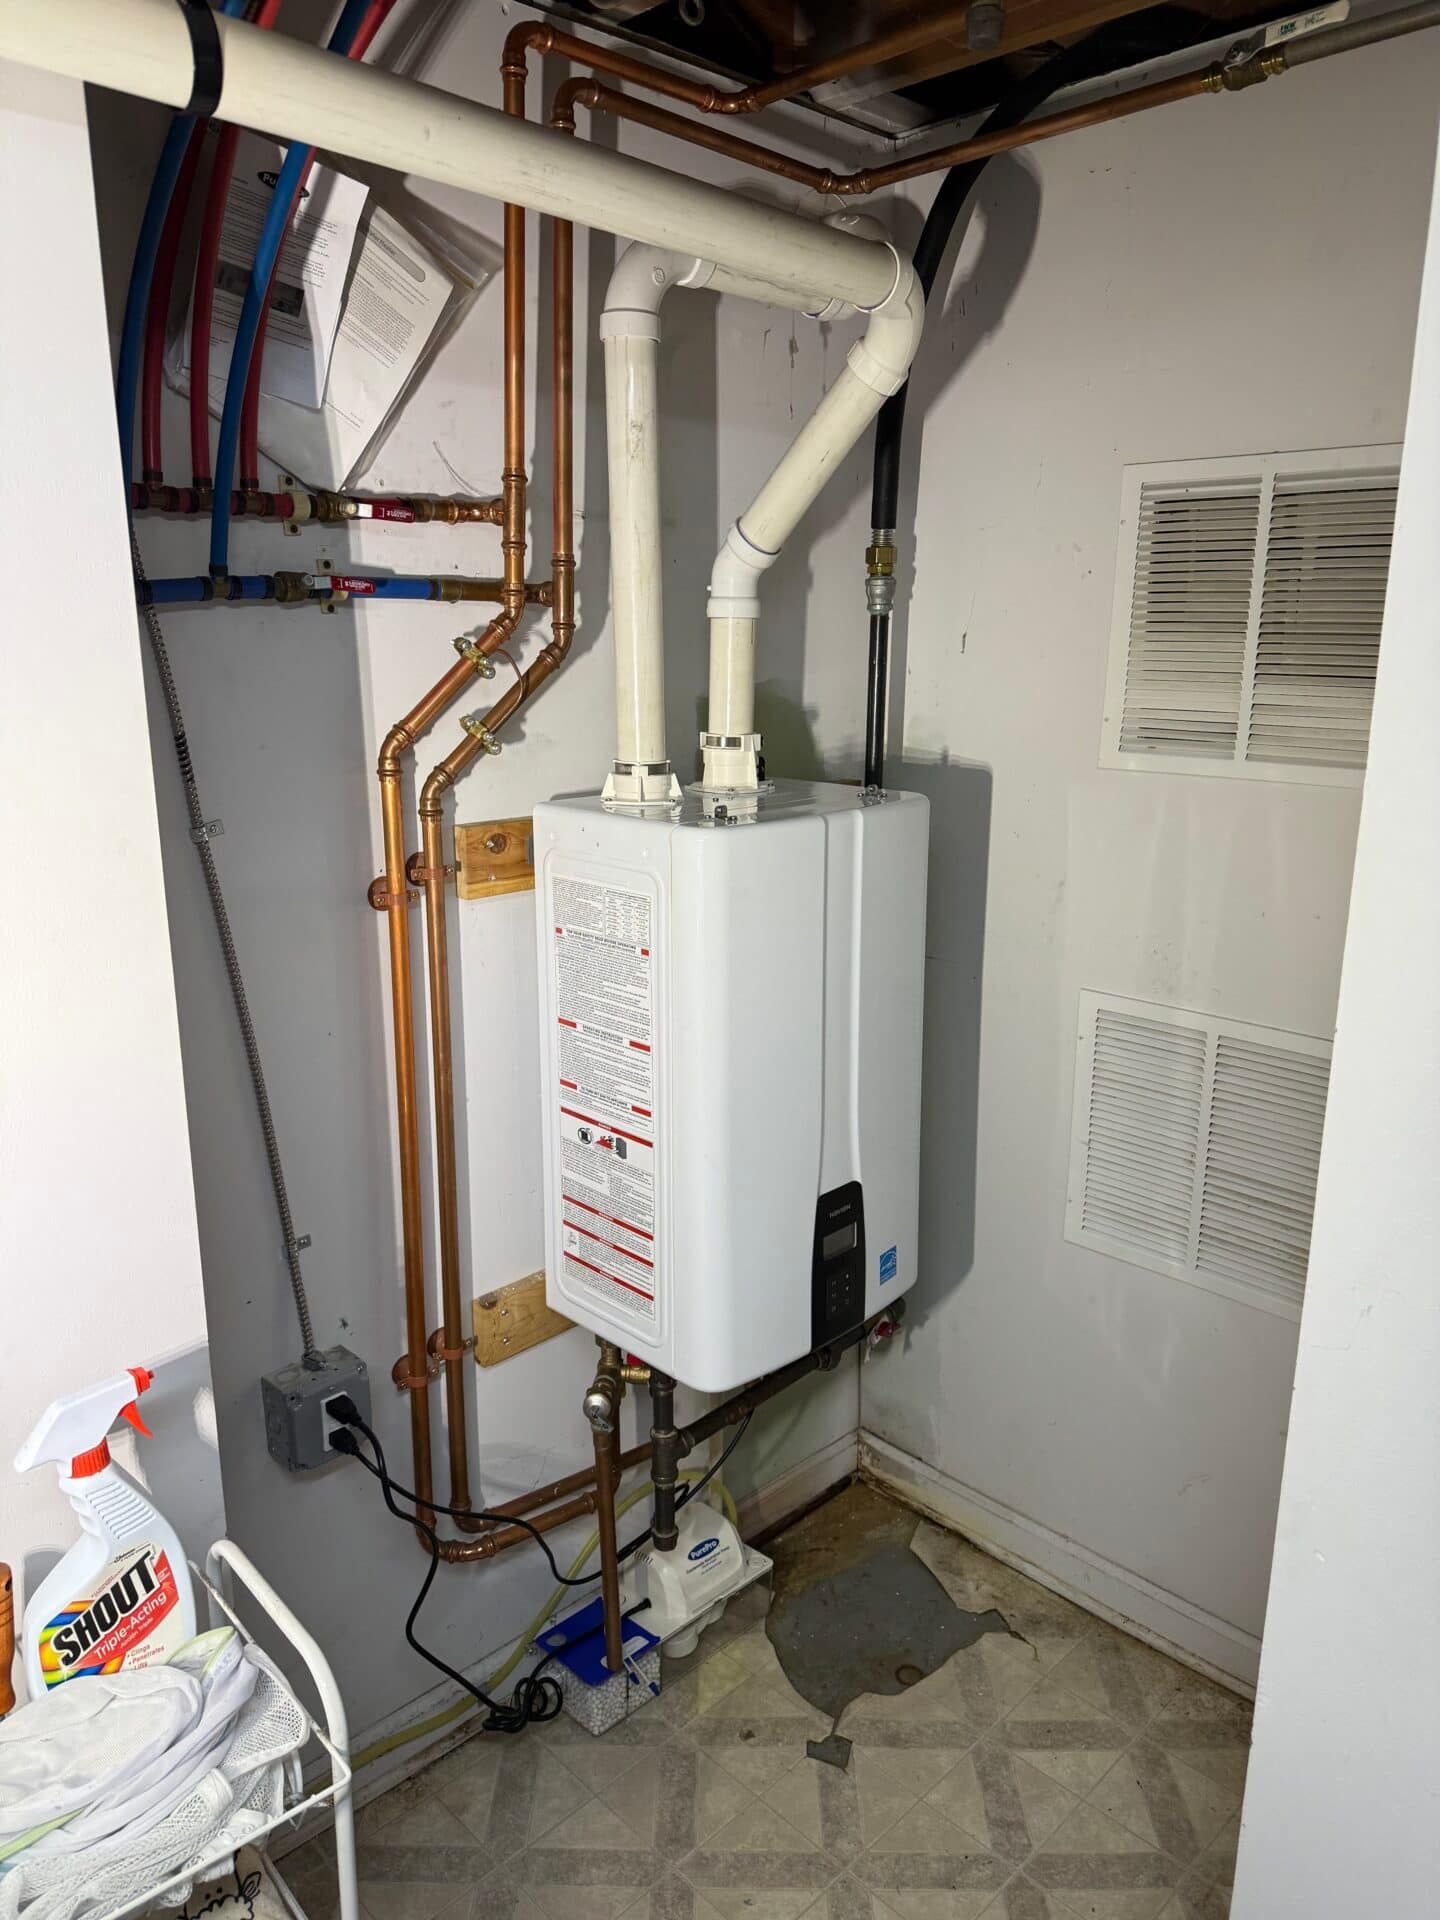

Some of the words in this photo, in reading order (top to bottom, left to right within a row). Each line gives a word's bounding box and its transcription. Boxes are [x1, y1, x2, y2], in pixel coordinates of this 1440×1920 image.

[690, 1540, 717, 1560] PurePro
[53, 1550, 156, 1666] SHOUT
[94, 1591, 167, 1659] Triple-Acting
